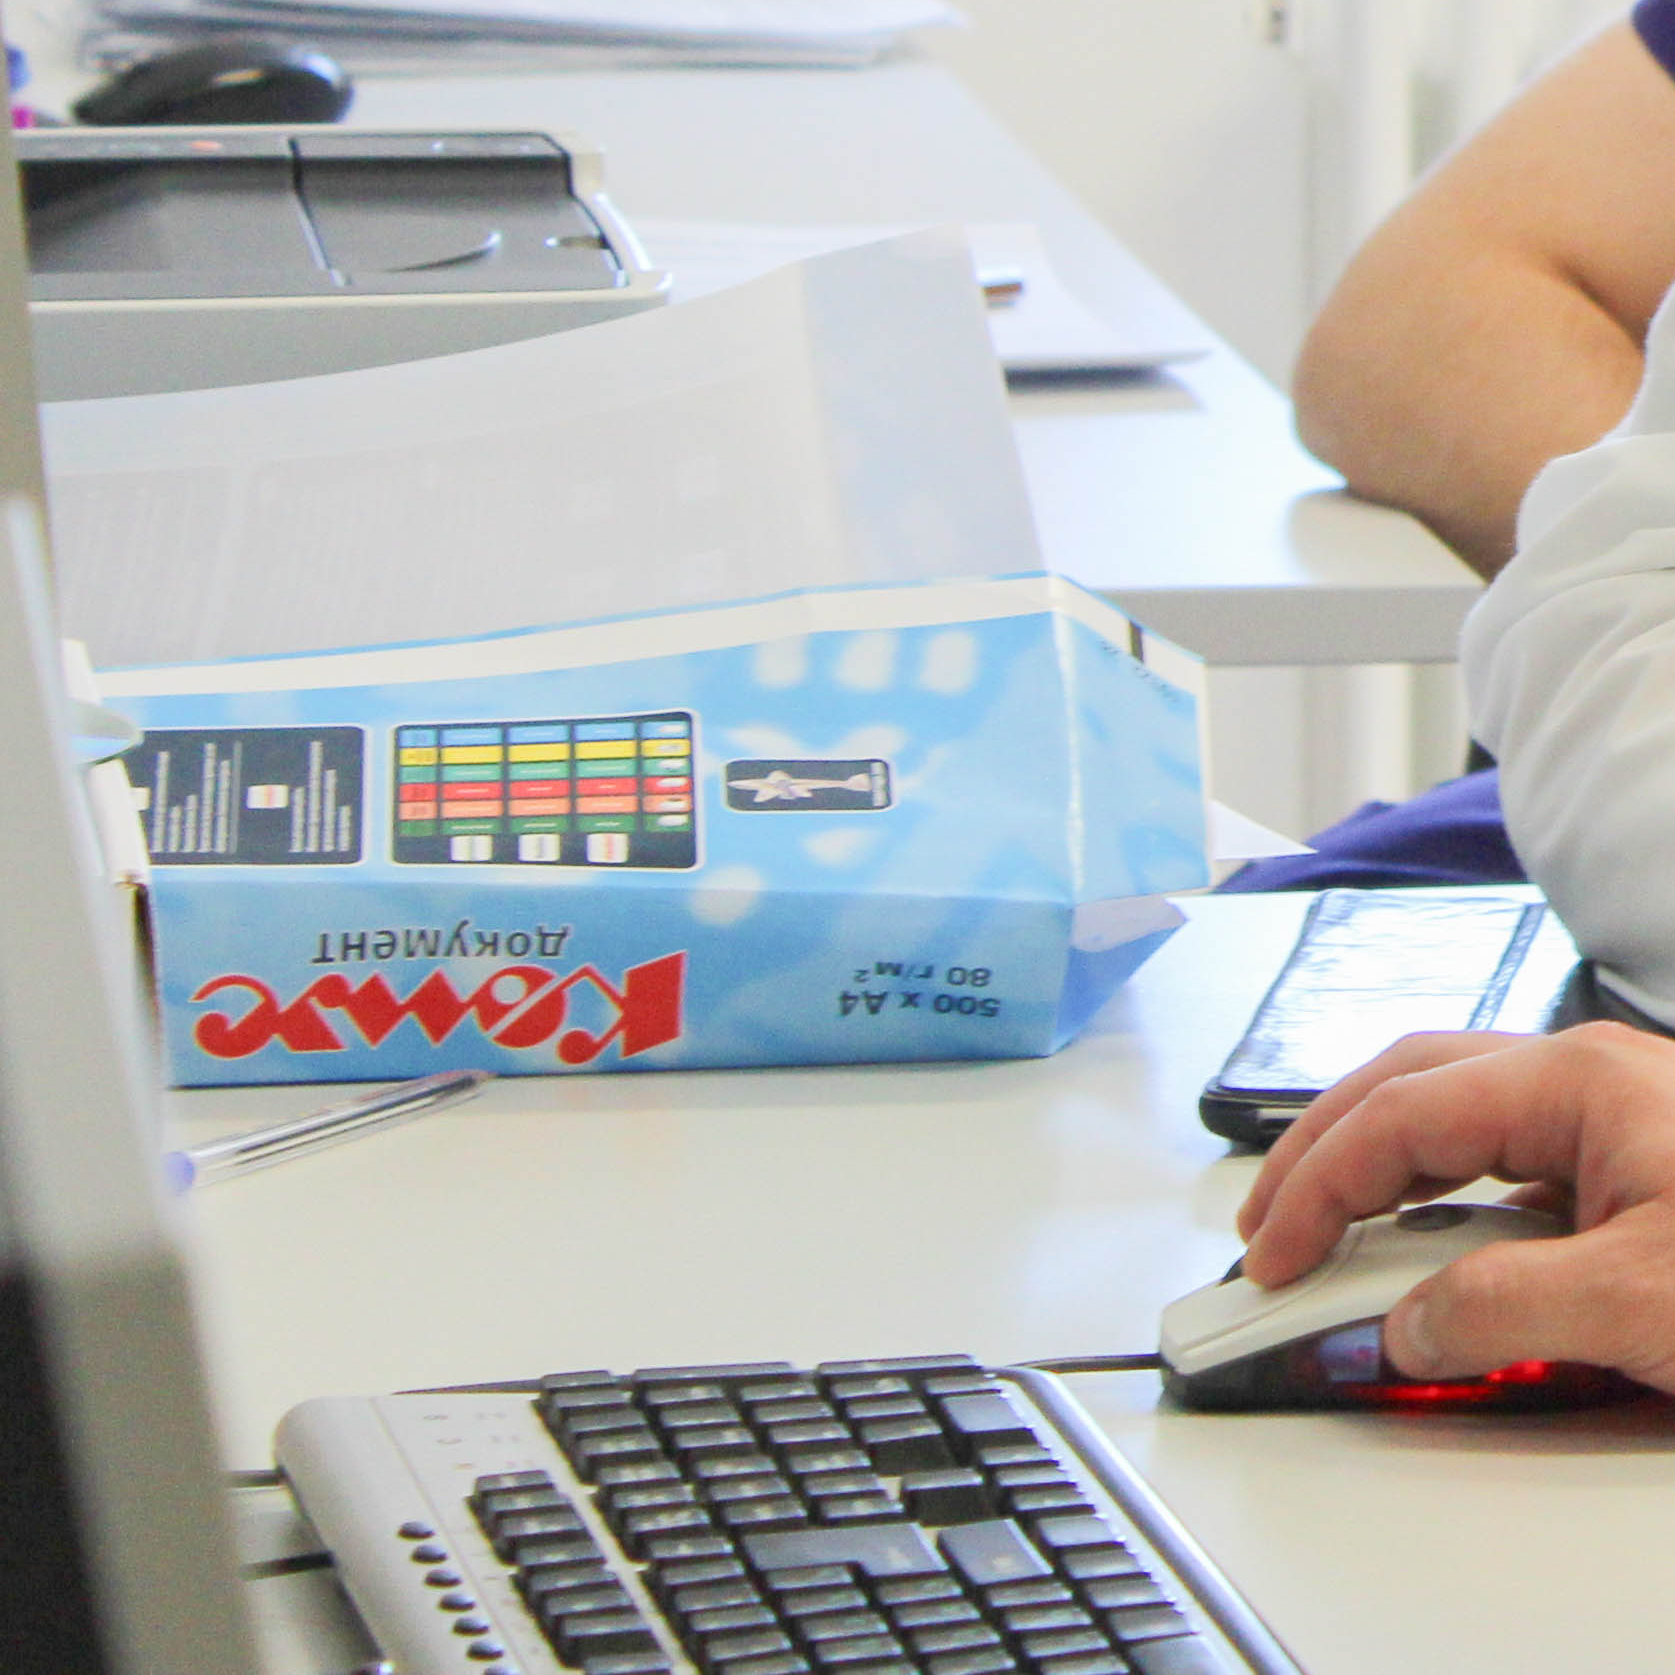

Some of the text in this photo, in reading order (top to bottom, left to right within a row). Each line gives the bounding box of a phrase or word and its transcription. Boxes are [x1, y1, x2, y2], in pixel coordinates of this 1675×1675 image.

[311, 922, 569, 965] документ
[946, 967, 991, 988] 80
[933, 994, 1001, 1018] 500
